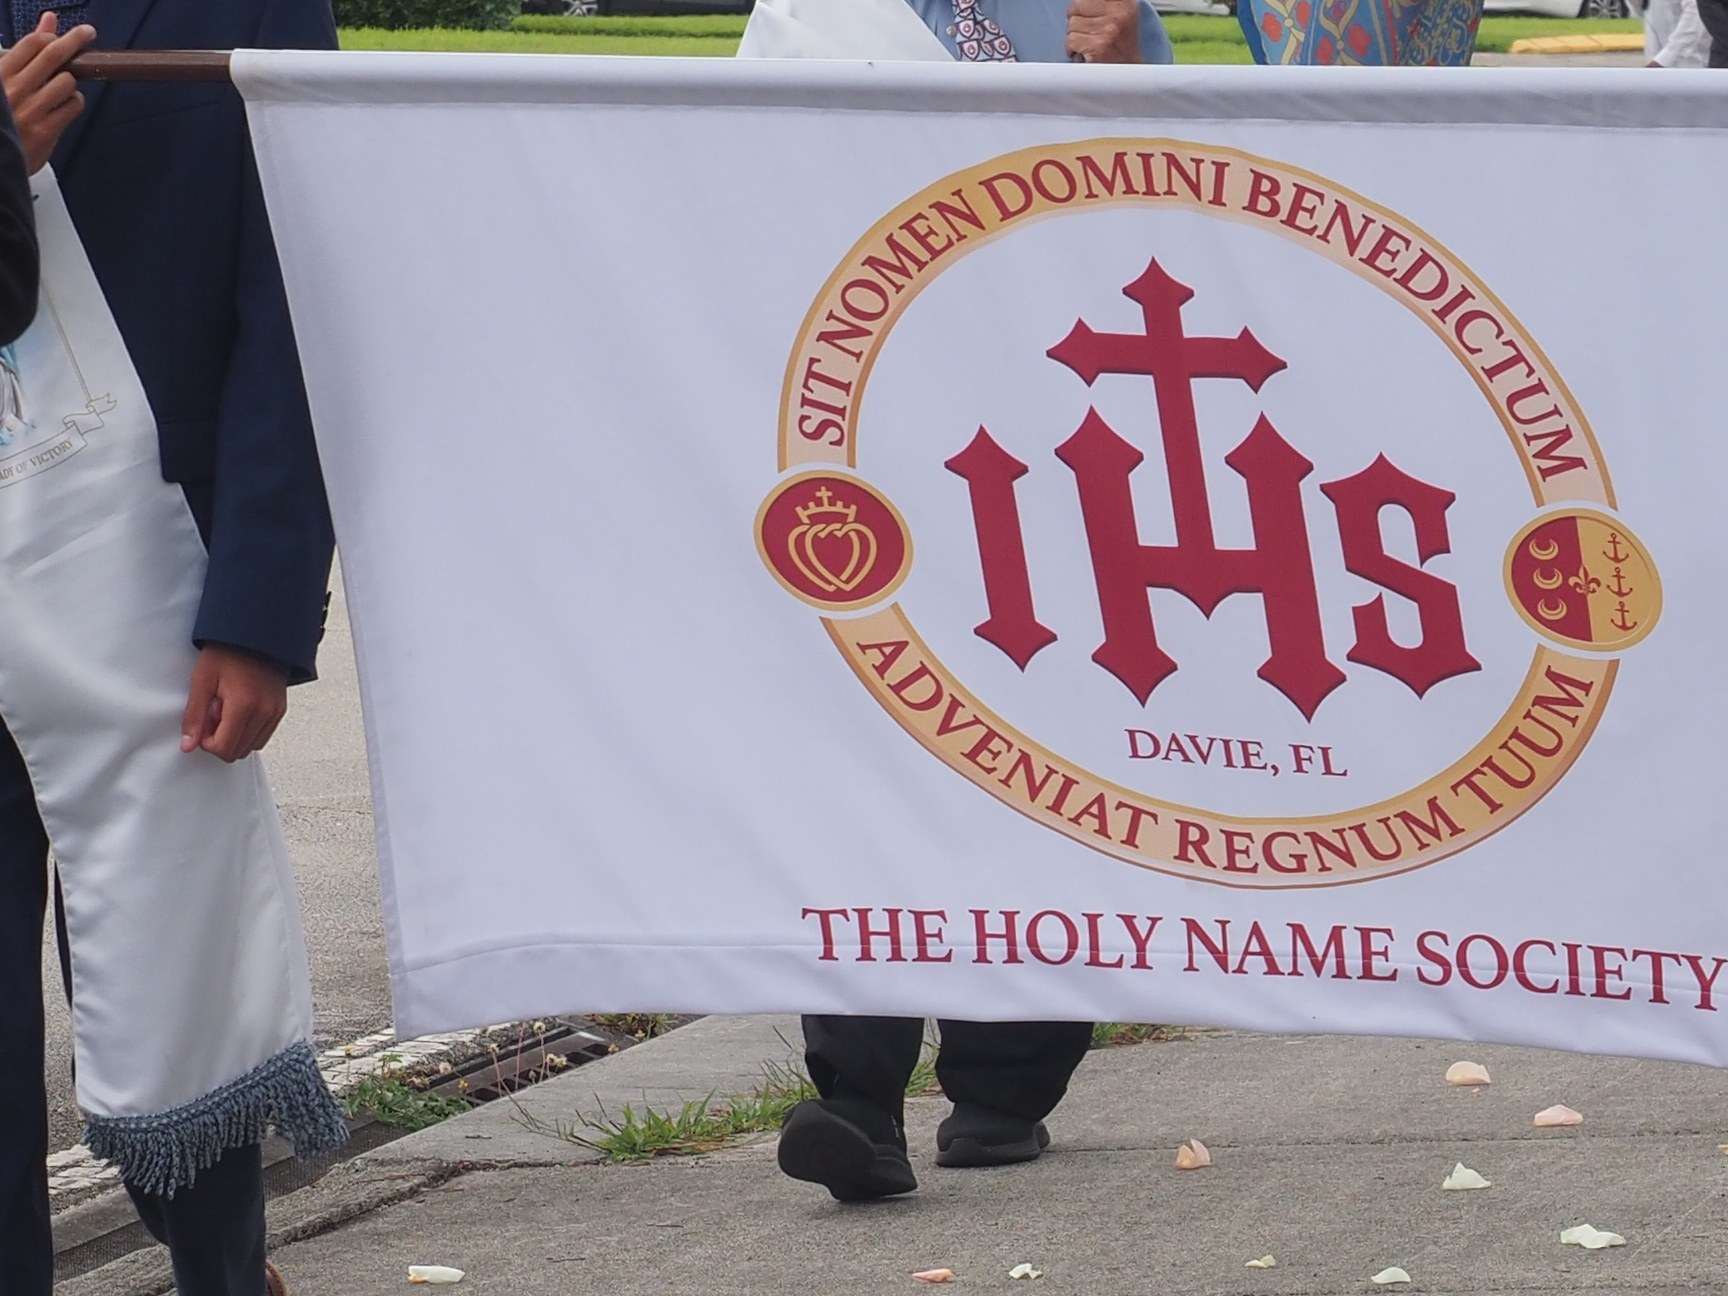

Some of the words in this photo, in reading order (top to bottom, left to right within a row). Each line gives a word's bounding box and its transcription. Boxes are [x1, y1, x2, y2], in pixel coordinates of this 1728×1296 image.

[976, 150, 1231, 224] DOMINI
[815, 186, 987, 364] NOMEN
[1242, 168, 1588, 482] BENEDICTUM
[797, 356, 854, 448] SIT
[15, 460, 29, 474] OF
[29, 436, 73, 468] VICTORY
[944, 256, 1483, 723] IHS
[856, 639, 1160, 850] ADVENIAT
[1173, 794, 1467, 875] REGNUM
[1448, 663, 1595, 816] TUUM
[1124, 728, 1278, 777] DAVIE,
[1292, 743, 1349, 778] FL
[800, 907, 953, 964] THE
[971, 909, 1161, 971] HOLY
[1183, 917, 1399, 986] NAME
[1415, 930, 1728, 1012] SOCIETY
